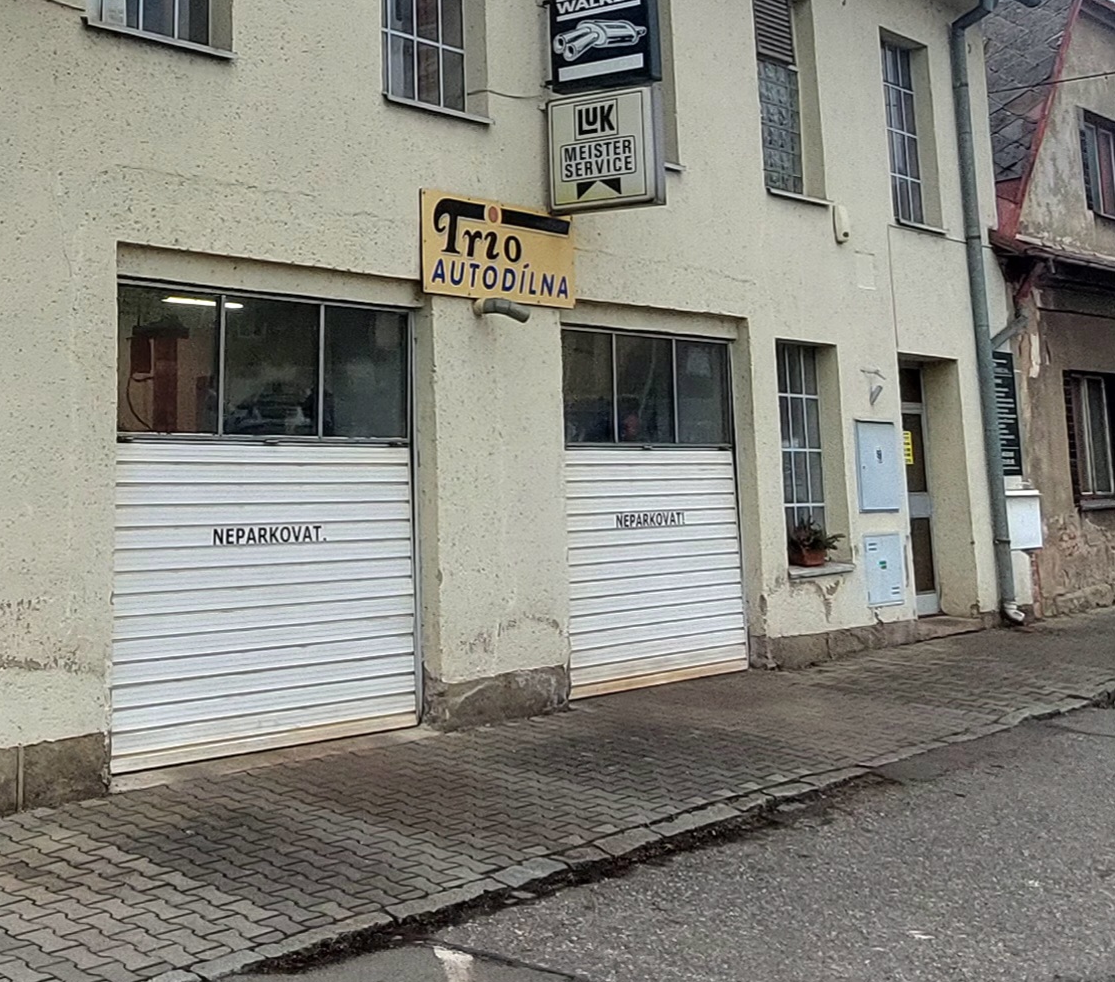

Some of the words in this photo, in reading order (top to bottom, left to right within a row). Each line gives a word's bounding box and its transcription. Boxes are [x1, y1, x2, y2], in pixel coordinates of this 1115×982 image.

[564, 139, 632, 163] MEISTER
[565, 155, 633, 178] SERVICE
[433, 198, 522, 263] Trio
[431, 258, 568, 299] AUTODÍLNA
